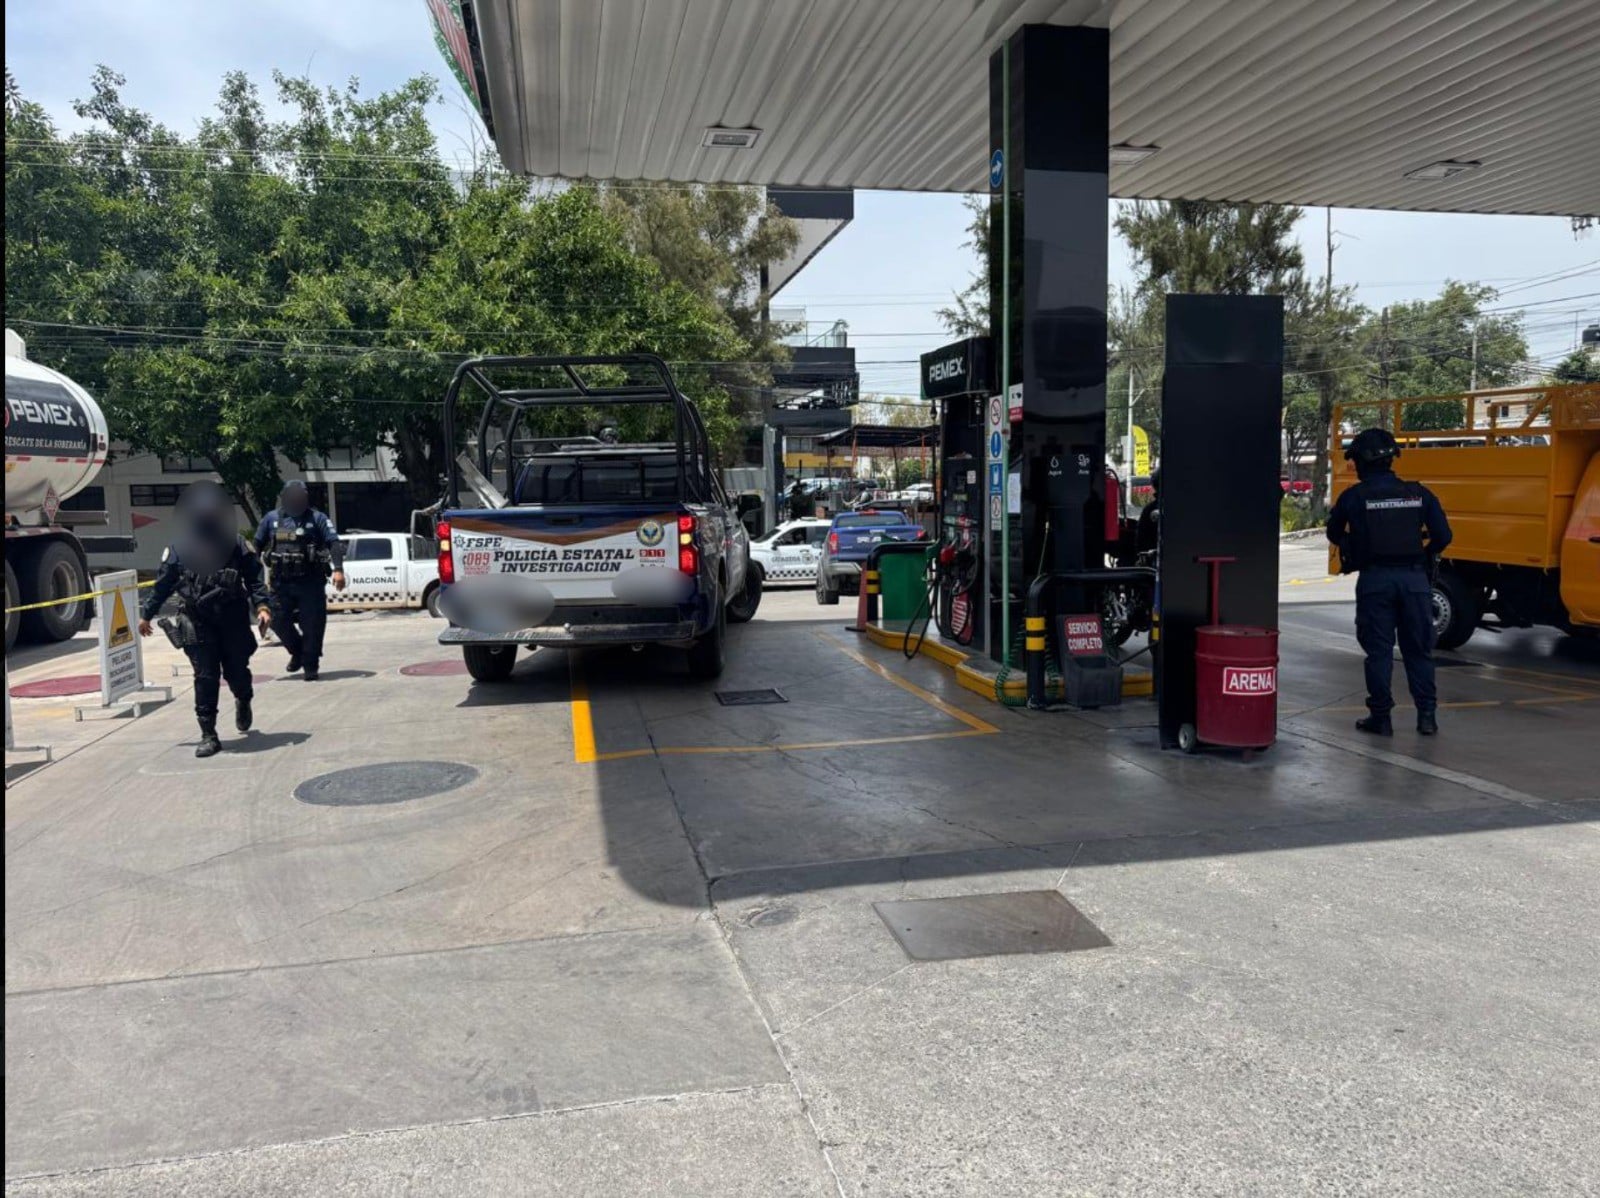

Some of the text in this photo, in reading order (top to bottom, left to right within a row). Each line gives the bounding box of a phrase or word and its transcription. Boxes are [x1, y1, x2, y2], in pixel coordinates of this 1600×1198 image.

[929, 357, 964, 382] PEMEX
[8, 399, 77, 427] PEMEX
[467, 537, 502, 548] FSPE
[467, 552, 490, 566] 089
[493, 547, 635, 562] POLICÍA ESTATAL
[640, 549, 665, 557] 911
[501, 560, 621, 573] INVESTIGACIÓN
[1068, 622, 1098, 635] SERVICIO
[1068, 637, 1103, 651] COMPLETO
[1229, 672, 1272, 690] ARENA
